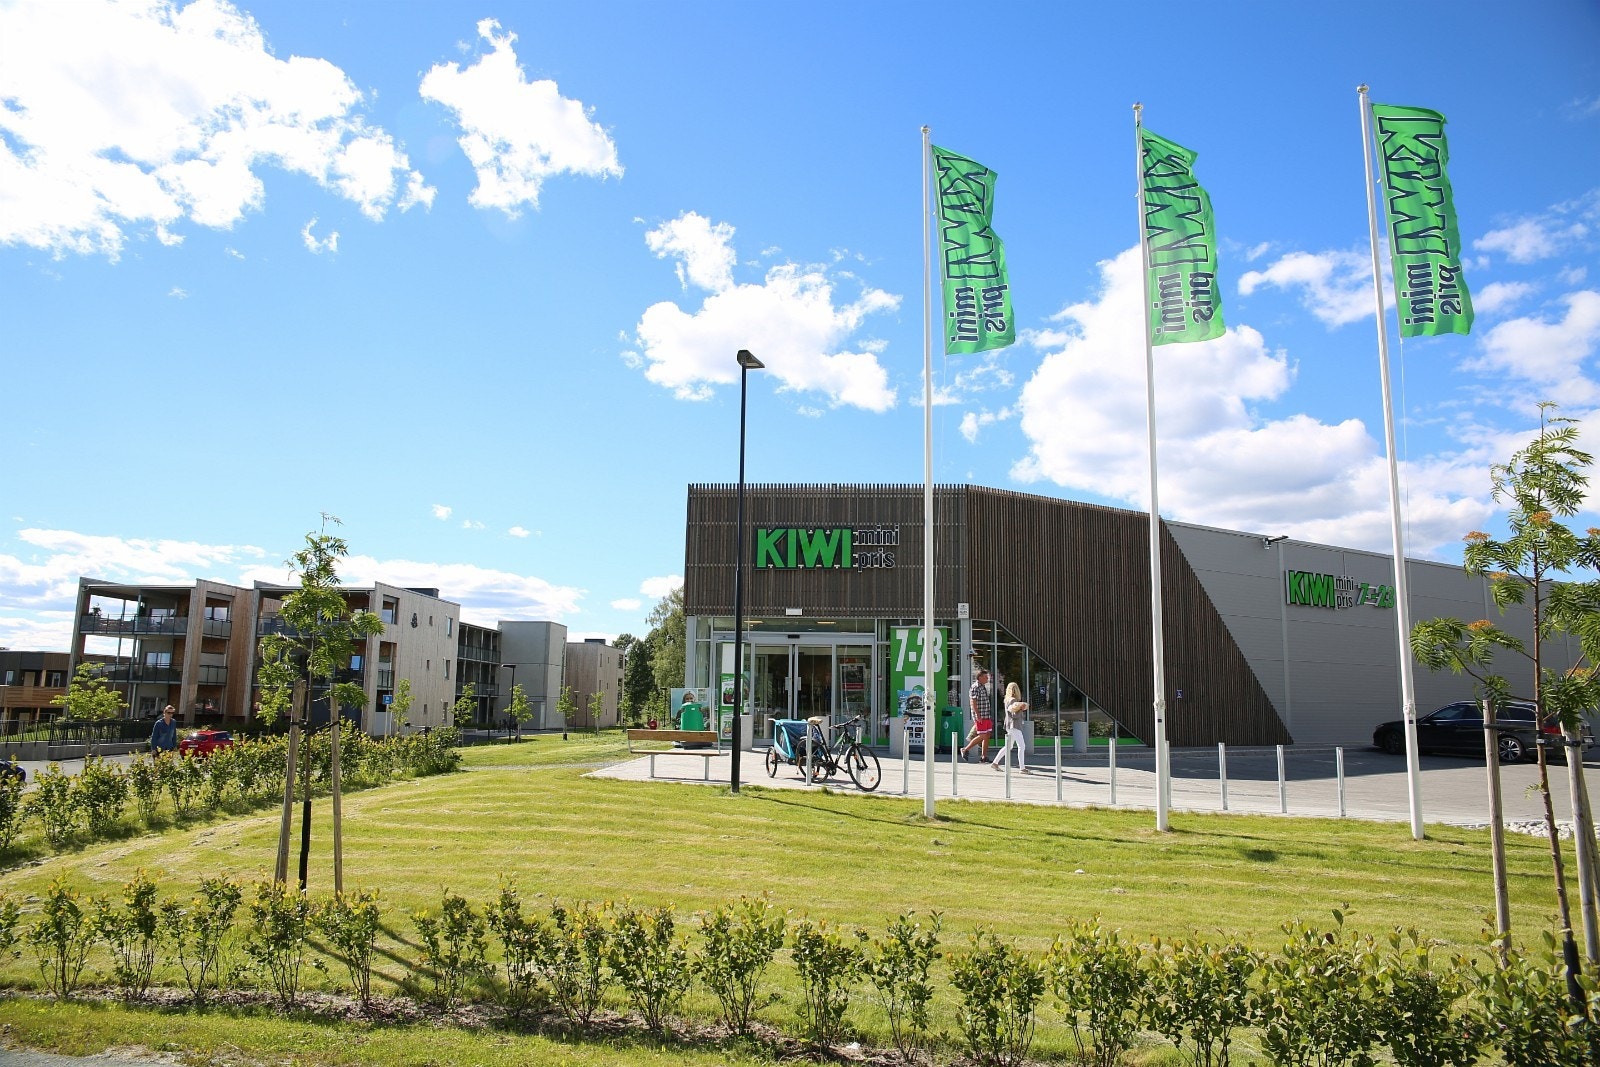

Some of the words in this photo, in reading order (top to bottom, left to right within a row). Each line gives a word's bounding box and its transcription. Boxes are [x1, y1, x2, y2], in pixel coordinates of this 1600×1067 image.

[857, 525, 899, 546] mini
[755, 527, 853, 570] KIWI
[857, 547, 896, 572] pris
[1287, 570, 1335, 608] KIWI
[1335, 576, 1354, 591] mini
[1336, 592, 1353, 609] pris
